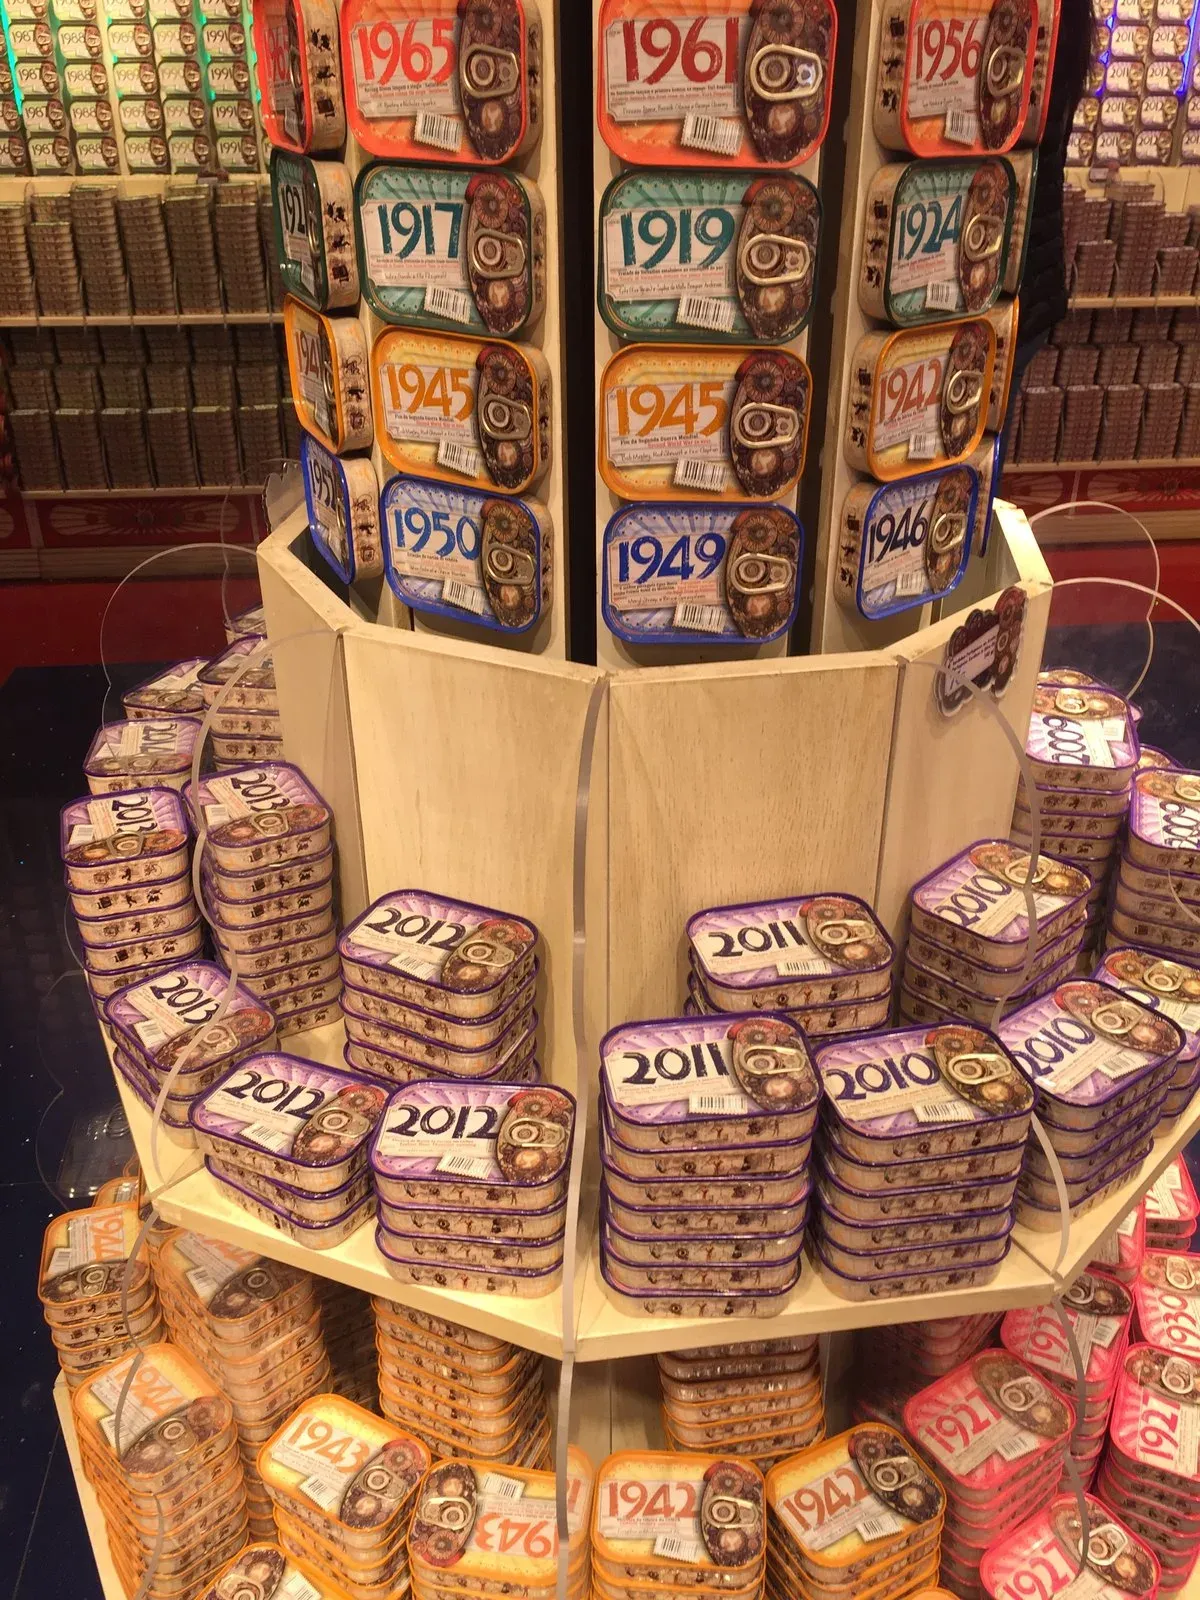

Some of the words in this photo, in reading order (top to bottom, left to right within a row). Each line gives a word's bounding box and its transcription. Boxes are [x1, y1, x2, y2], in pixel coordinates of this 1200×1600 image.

[206, 30, 228, 43] 1991
[356, 18, 456, 86] 1965
[623, 16, 739, 85] 1961
[916, 18, 983, 83] 1956
[1115, 32, 1134, 42] 2011
[211, 68, 233, 81] 1991
[1110, 68, 1129, 78] 2011
[216, 105, 238, 118] 1991
[1105, 102, 1124, 113] 2011
[220, 142, 241, 155] 1991
[1100, 136, 1118, 147] 2011
[378, 202, 465, 259] 1917
[621, 207, 735, 270] 1919
[898, 194, 963, 261] 1924
[387, 363, 474, 421] 1945
[616, 381, 728, 437] 1945
[880, 358, 942, 421] 1942
[394, 507, 480, 561] 1950
[869, 499, 929, 563] 1946
[619, 532, 726, 584] 1949
[111, 796, 158, 834] 2013
[229, 772, 291, 813] 2013
[934, 874, 1011, 927] 2010
[364, 907, 466, 950] 2012
[708, 920, 808, 957] 2011
[150, 974, 222, 1025] 2013
[622, 1042, 729, 1085] 2011
[1011, 1017, 1096, 1077] 2010
[222, 1070, 325, 1120] 2012
[826, 1052, 940, 1101] 2010
[386, 1104, 499, 1140] 2012
[1158, 1293, 1200, 1352] 1930
[288, 1416, 371, 1473] 1943
[925, 1387, 1003, 1454] 1927
[1140, 1392, 1181, 1460] 1927
[608, 1480, 701, 1520] 1942
[783, 1468, 872, 1531] 1942
[474, 1512, 561, 1559] 1943
[1003, 1540, 1080, 1600] 1927
